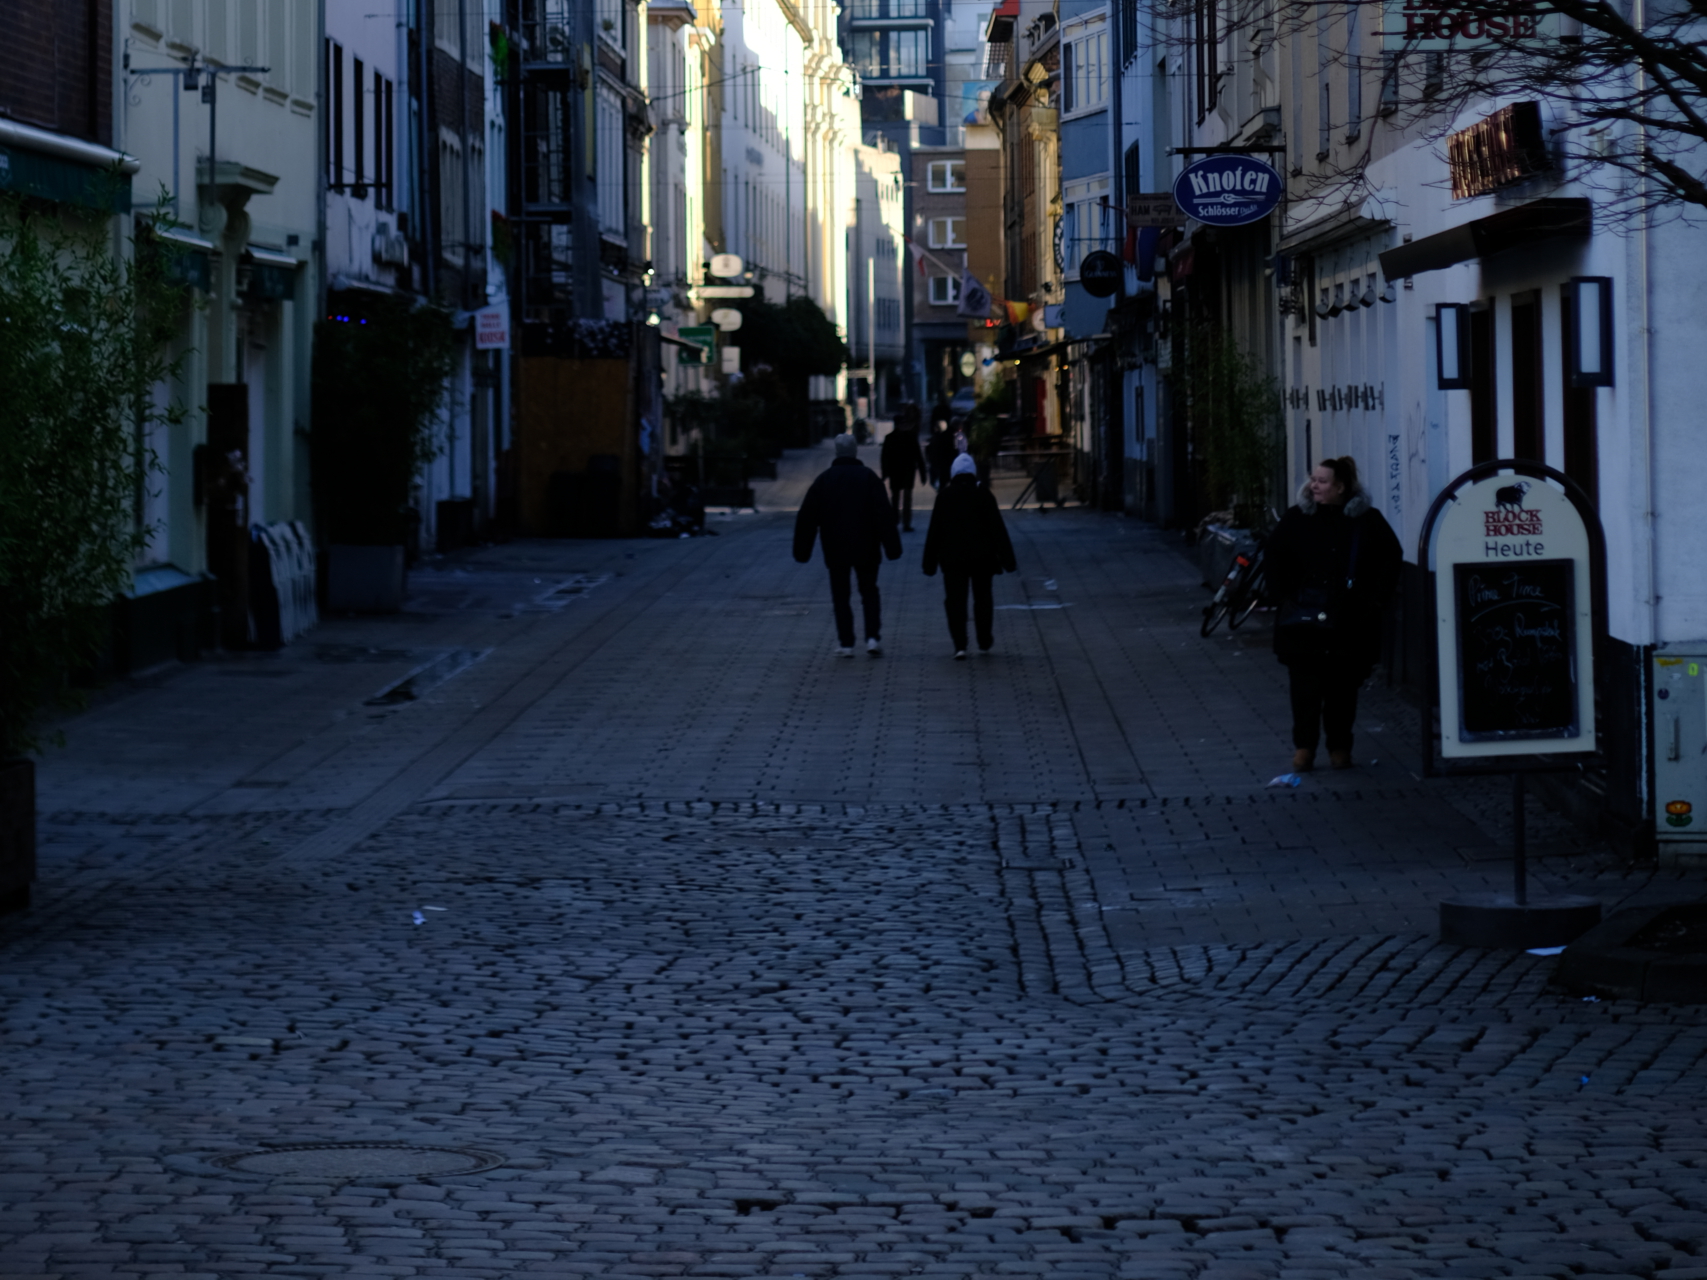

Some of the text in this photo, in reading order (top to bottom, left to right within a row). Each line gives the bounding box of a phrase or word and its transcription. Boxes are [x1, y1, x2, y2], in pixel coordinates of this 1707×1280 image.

[1403, 11, 1537, 40] HOUSE
[1188, 166, 1270, 196] Knoten
[1131, 205, 1150, 215] HAM
[1198, 204, 1239, 218] Schlösser
[1484, 509, 1542, 524] BLOCK
[1484, 523, 1543, 537] HOUSE
[1485, 540, 1545, 558] Heute
[1468, 571, 1545, 607] Prime Time
